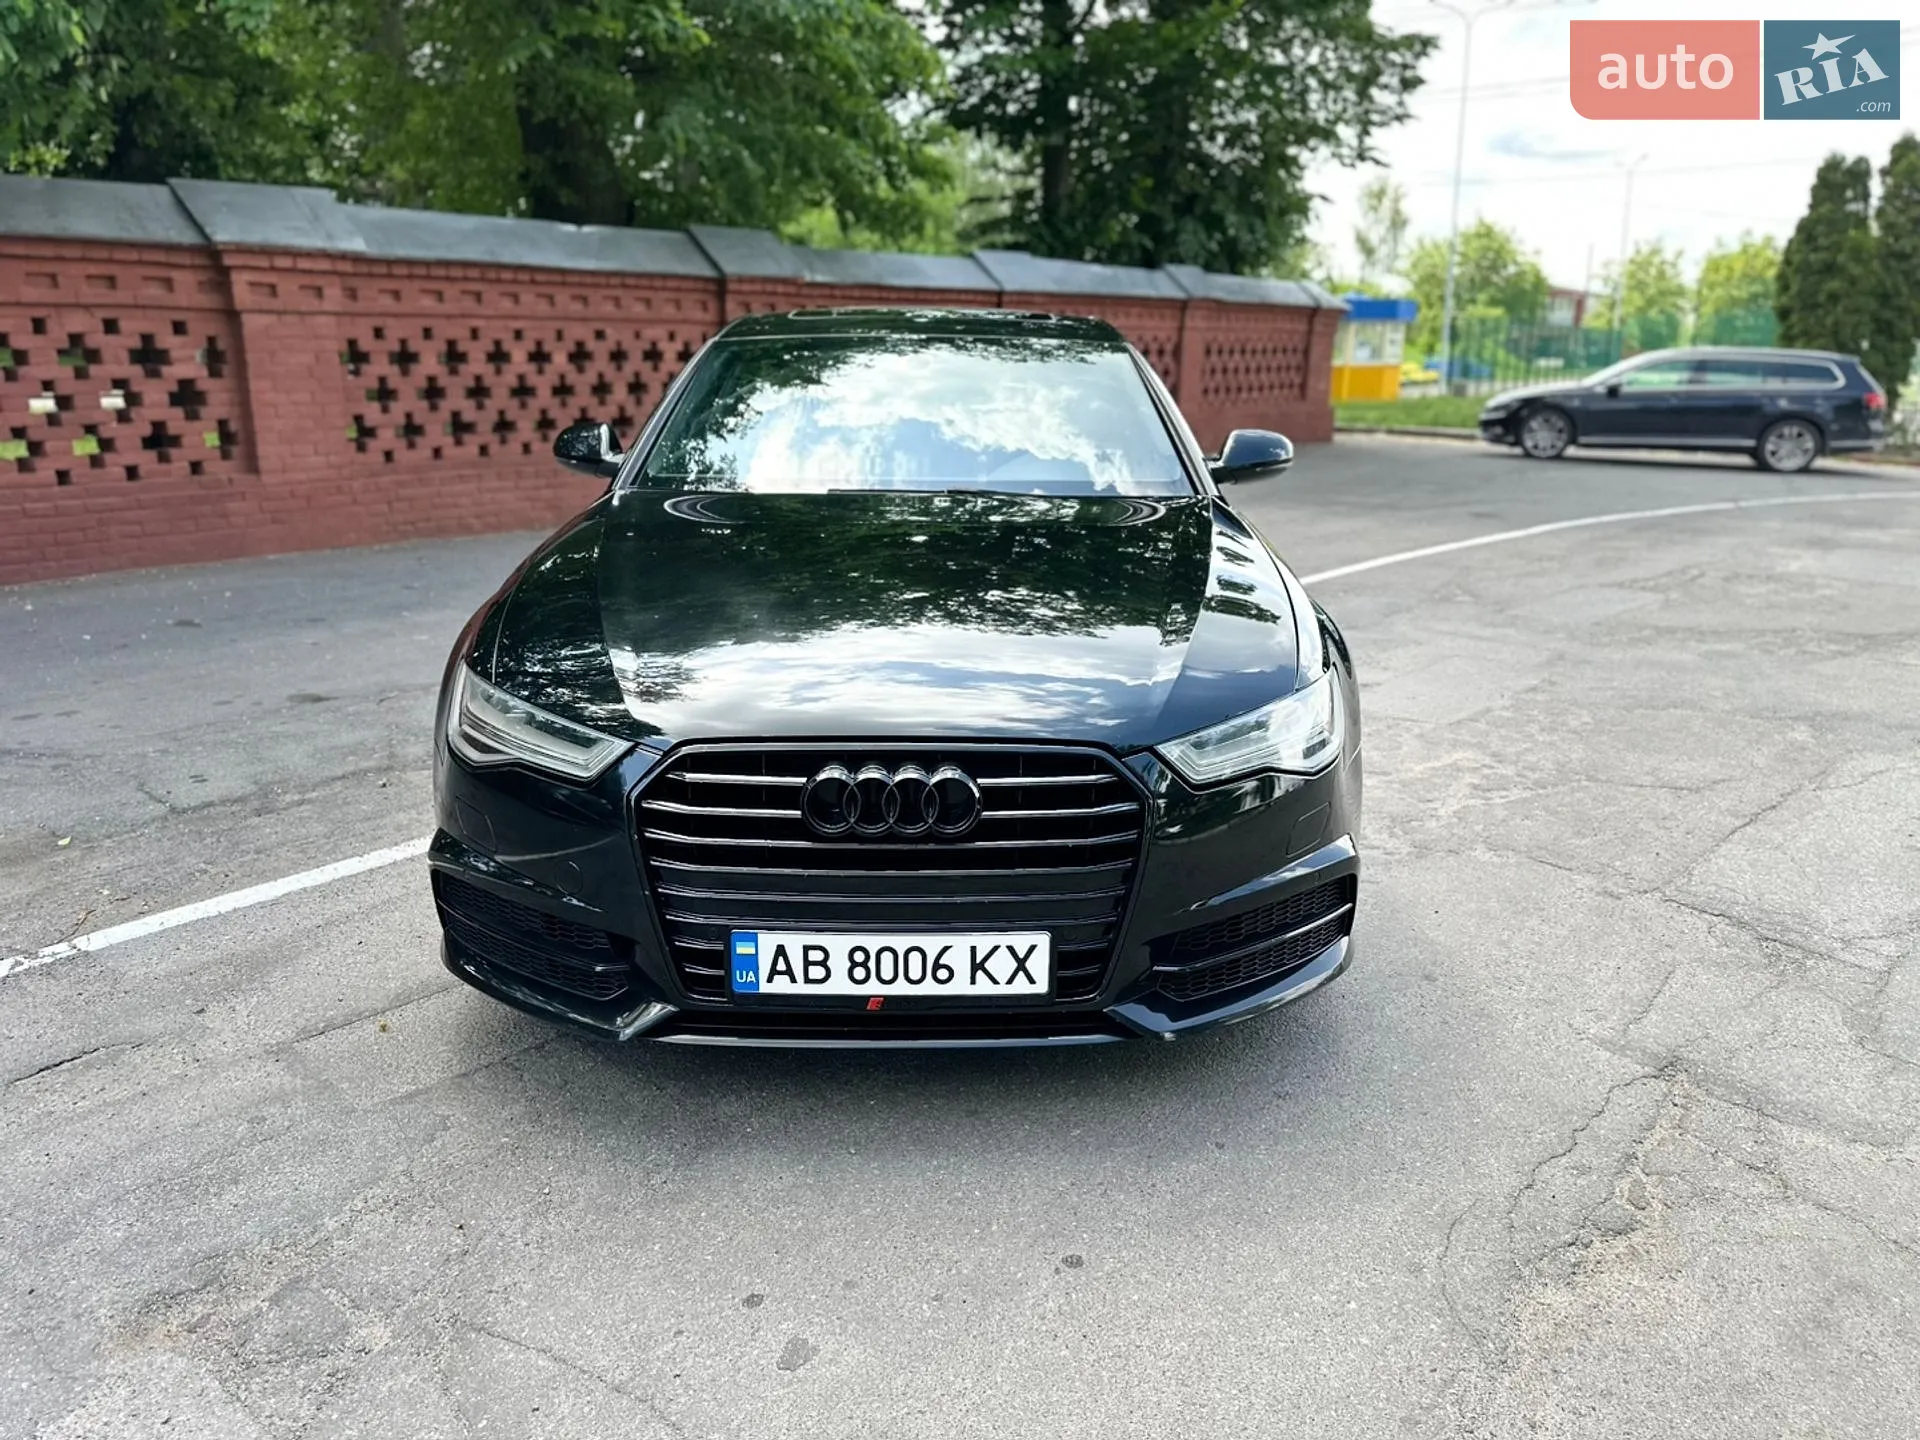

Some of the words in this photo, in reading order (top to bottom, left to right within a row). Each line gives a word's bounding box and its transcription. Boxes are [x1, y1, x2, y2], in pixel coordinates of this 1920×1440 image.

[736, 970, 757, 984] UA
[766, 944, 832, 985] AB
[847, 944, 955, 986] 8006
[969, 944, 1038, 986] KX
